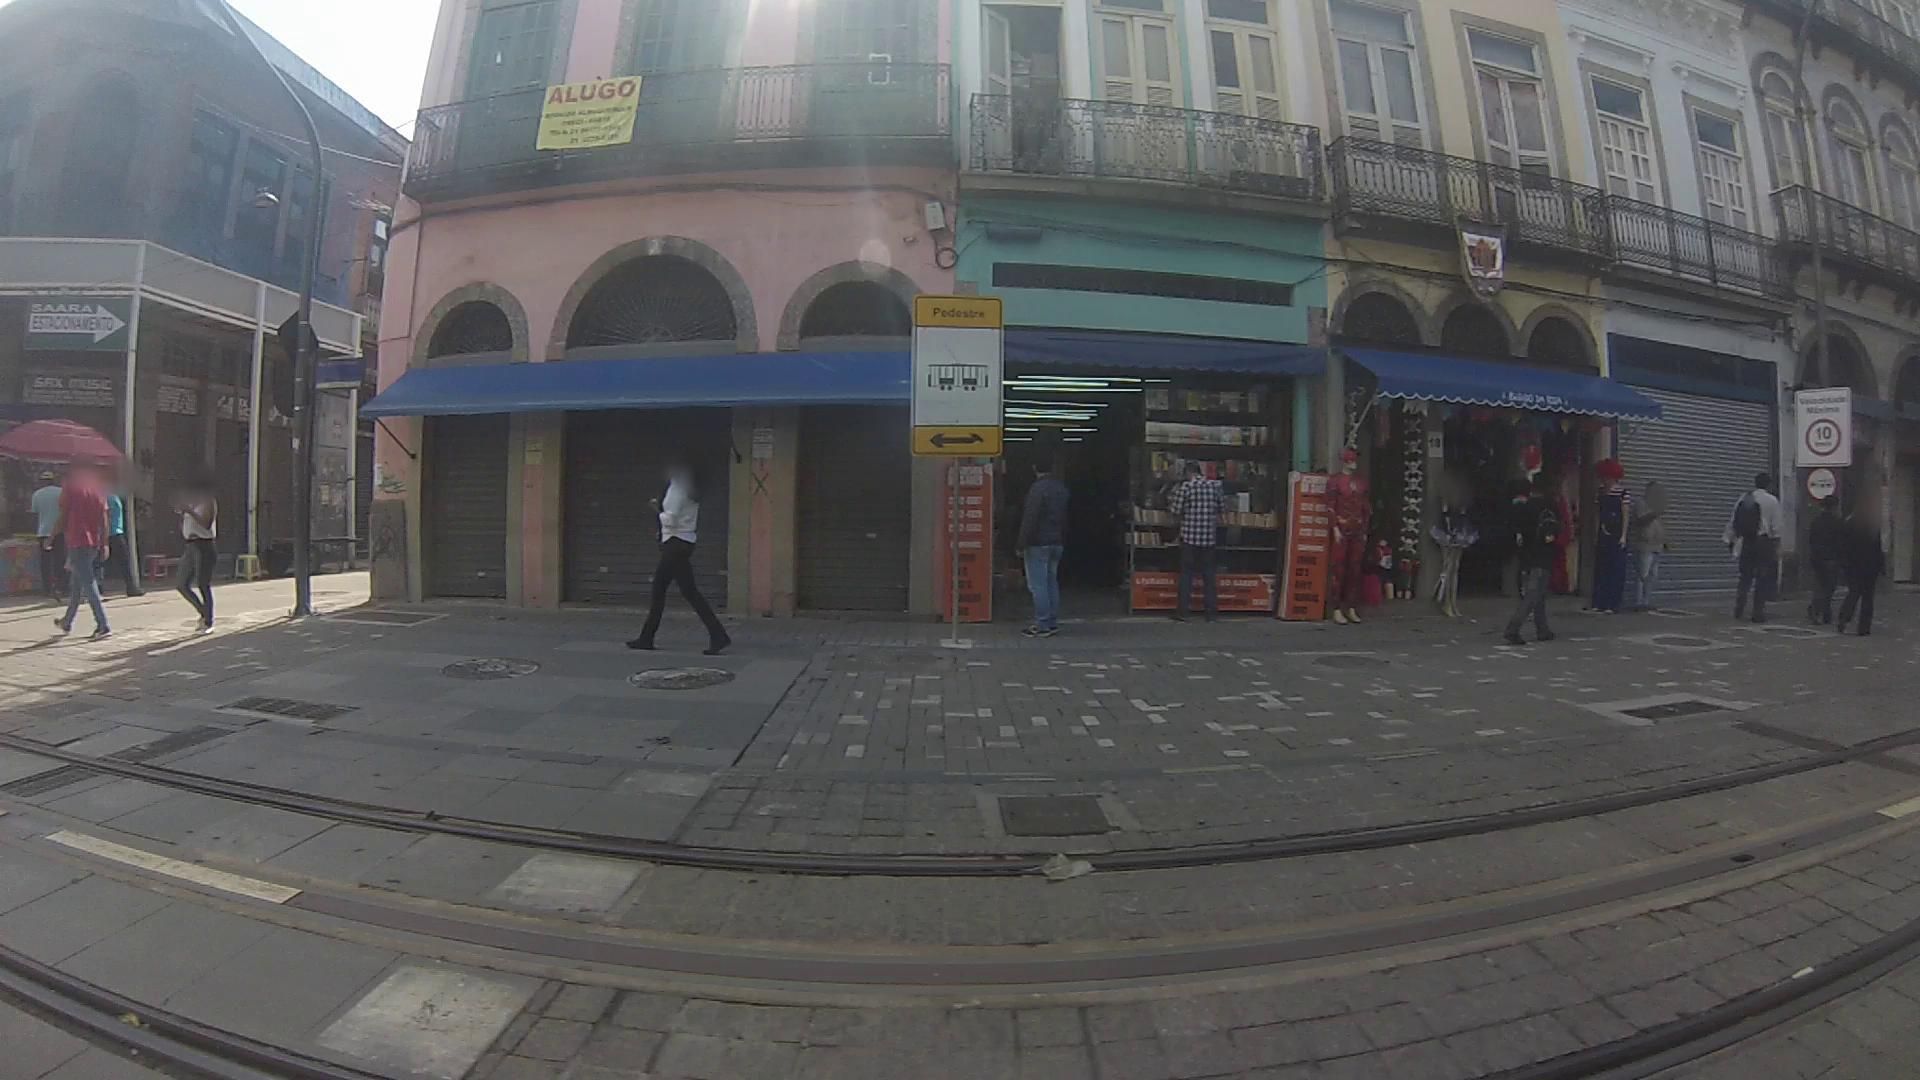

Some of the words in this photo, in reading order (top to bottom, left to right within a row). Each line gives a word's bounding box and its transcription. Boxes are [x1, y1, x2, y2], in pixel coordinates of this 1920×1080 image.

[548, 80, 636, 104] ALUGO
[32, 303, 93, 313] SAARA
[932, 307, 985, 319] Pedestre
[1816, 426, 1832, 440] 10
